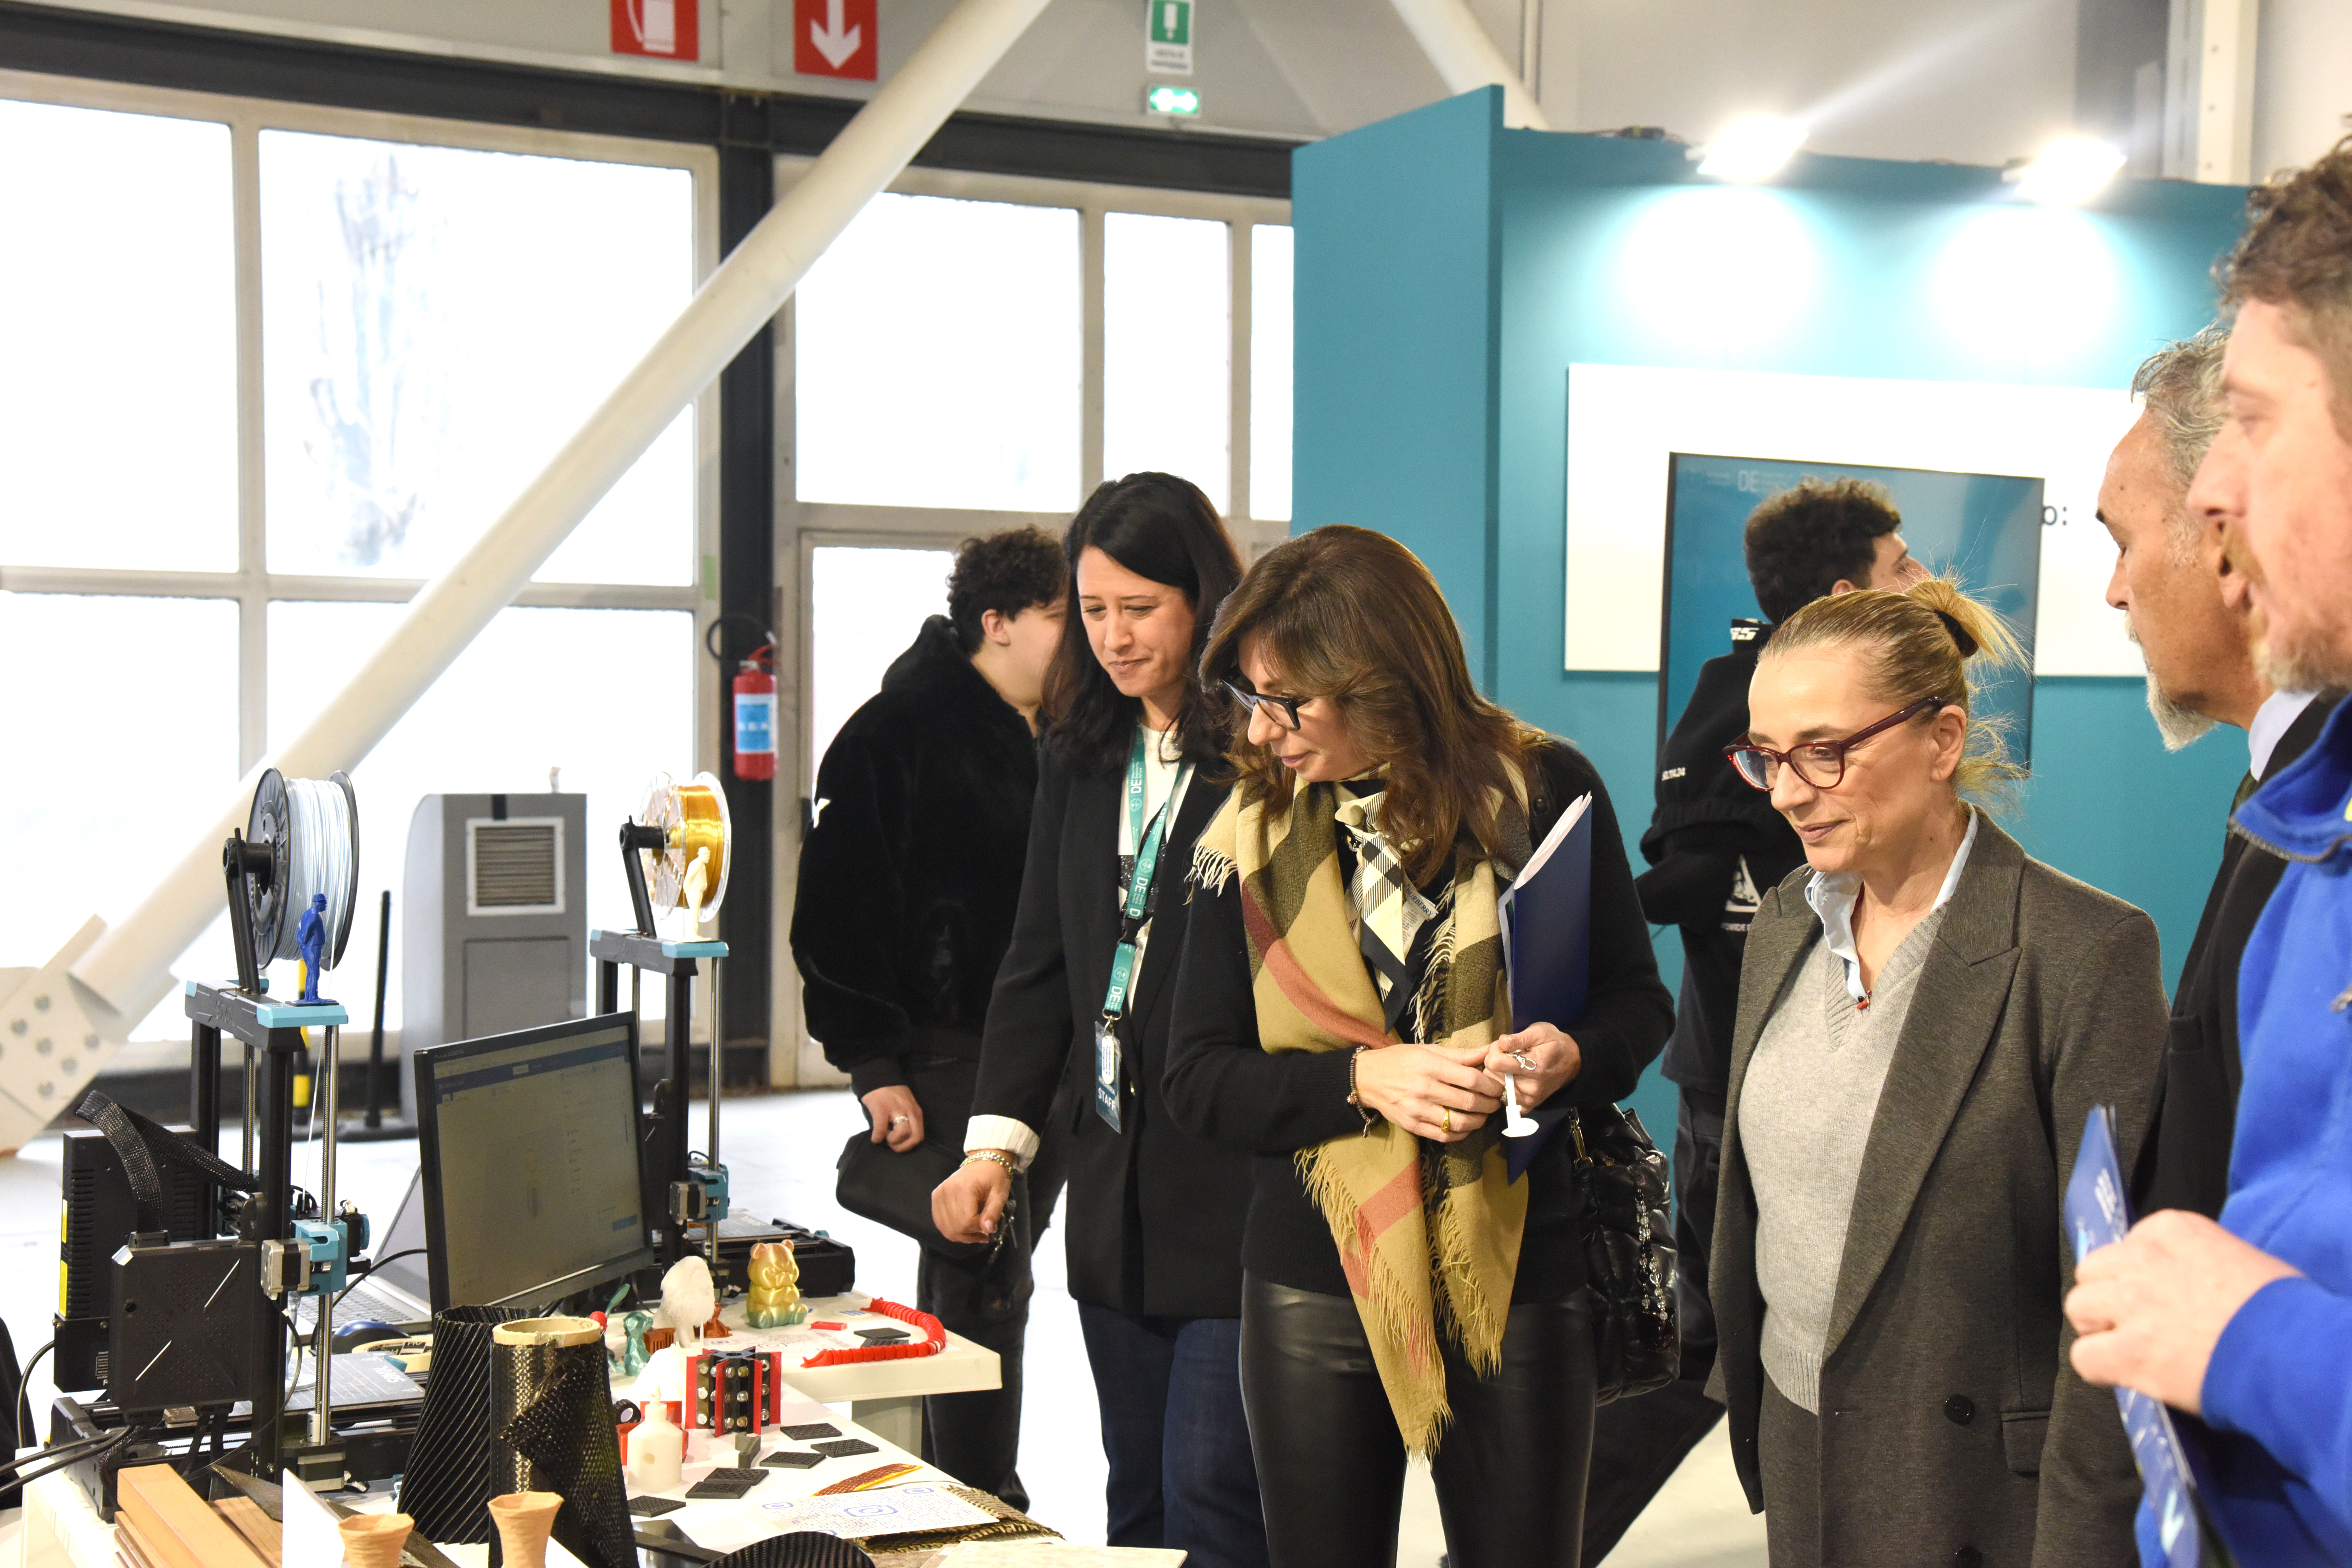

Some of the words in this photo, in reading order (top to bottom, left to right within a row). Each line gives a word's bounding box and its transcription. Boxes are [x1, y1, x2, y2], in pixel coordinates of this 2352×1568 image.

[1130, 779, 1142, 794] DE
[1157, 808, 1167, 823] DE
[1134, 876, 1148, 894] DE
[1129, 908, 1141, 919] D
[1109, 986, 1123, 1003] DE
[1098, 1087, 1115, 1110] STAFF
